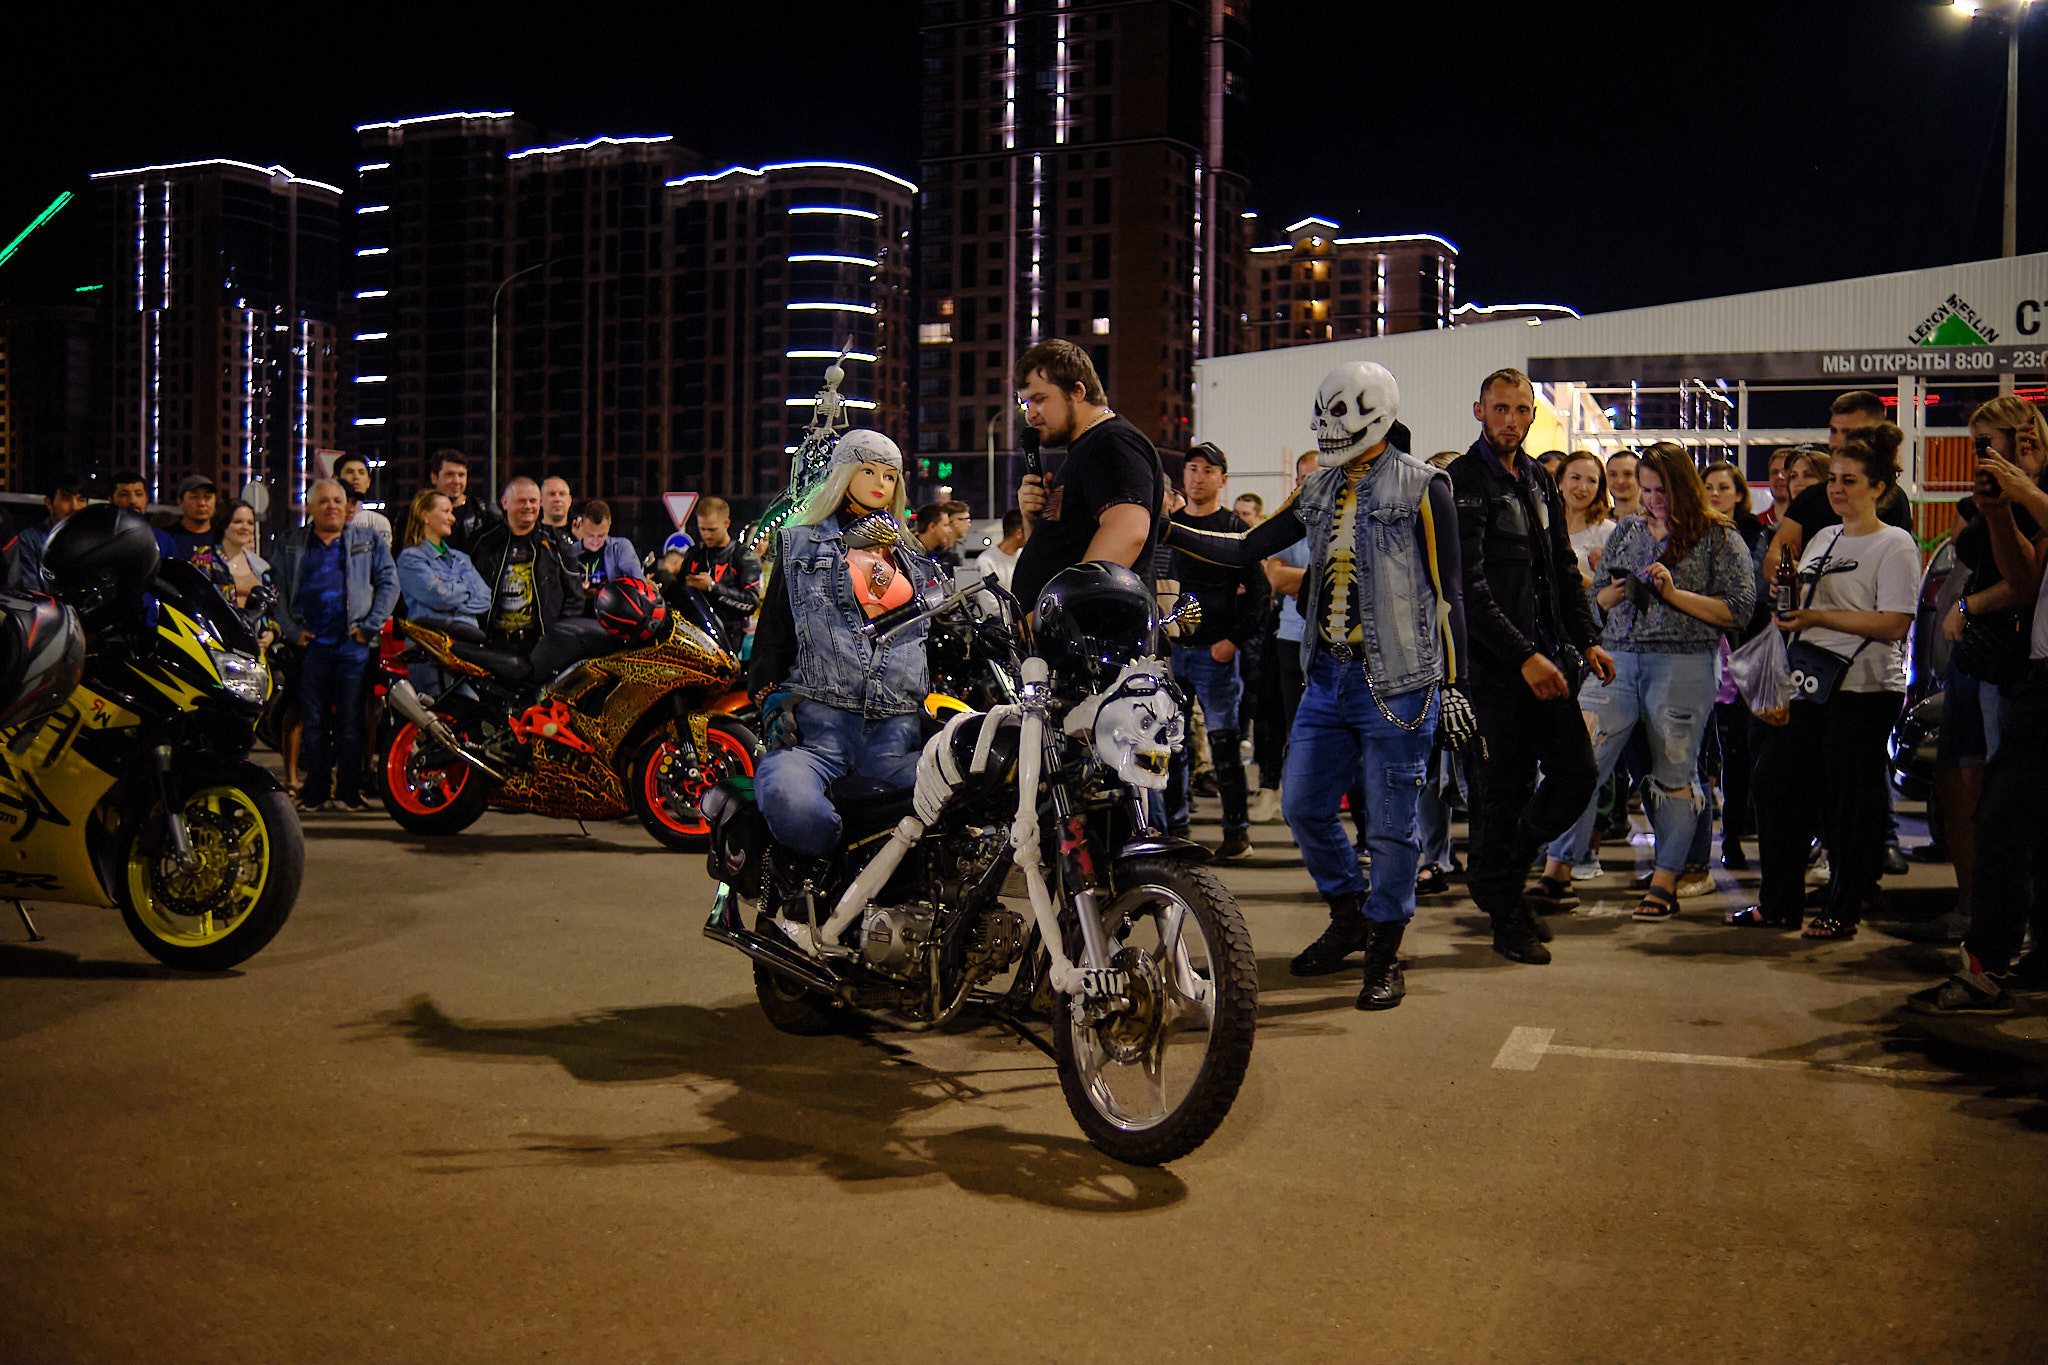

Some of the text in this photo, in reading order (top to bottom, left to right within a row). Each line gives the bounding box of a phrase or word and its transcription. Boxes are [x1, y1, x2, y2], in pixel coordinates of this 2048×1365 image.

[1908, 293, 2000, 345] LEROY MERLIN
[2016, 299, 2048, 336] С
[1822, 354, 1856, 374] МЫ
[1859, 352, 1952, 373] ОТКРЫТЫ
[1955, 351, 1994, 370] 8:00
